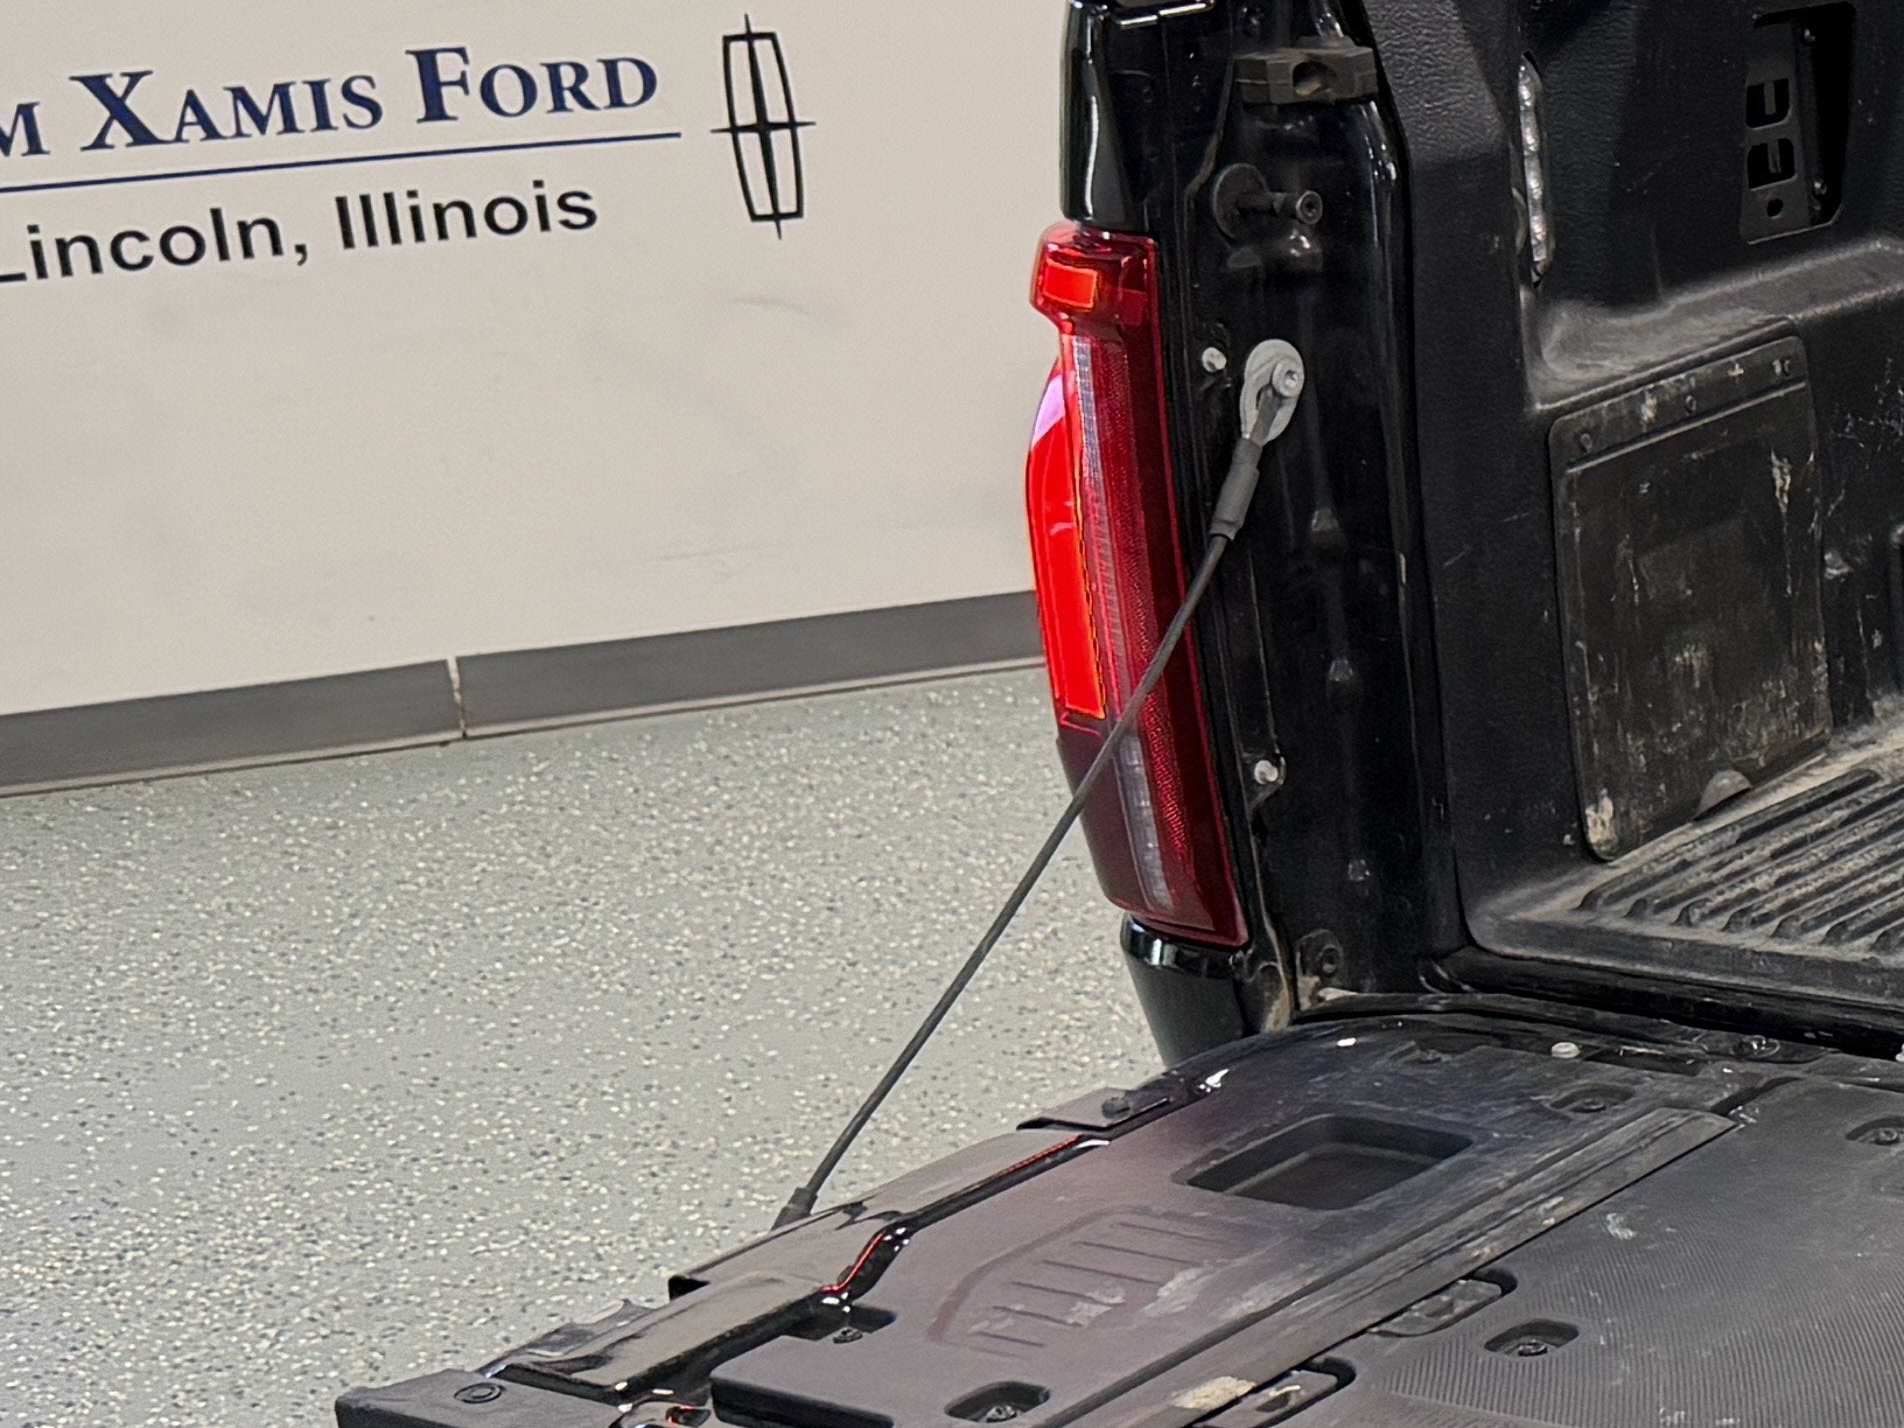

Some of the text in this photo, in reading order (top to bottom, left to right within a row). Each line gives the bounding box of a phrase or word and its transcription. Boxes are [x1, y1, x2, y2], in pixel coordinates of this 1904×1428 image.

[68, 70, 383, 153] XAMIS
[405, 46, 657, 125] FORD
[334, 179, 599, 251] Illinois
